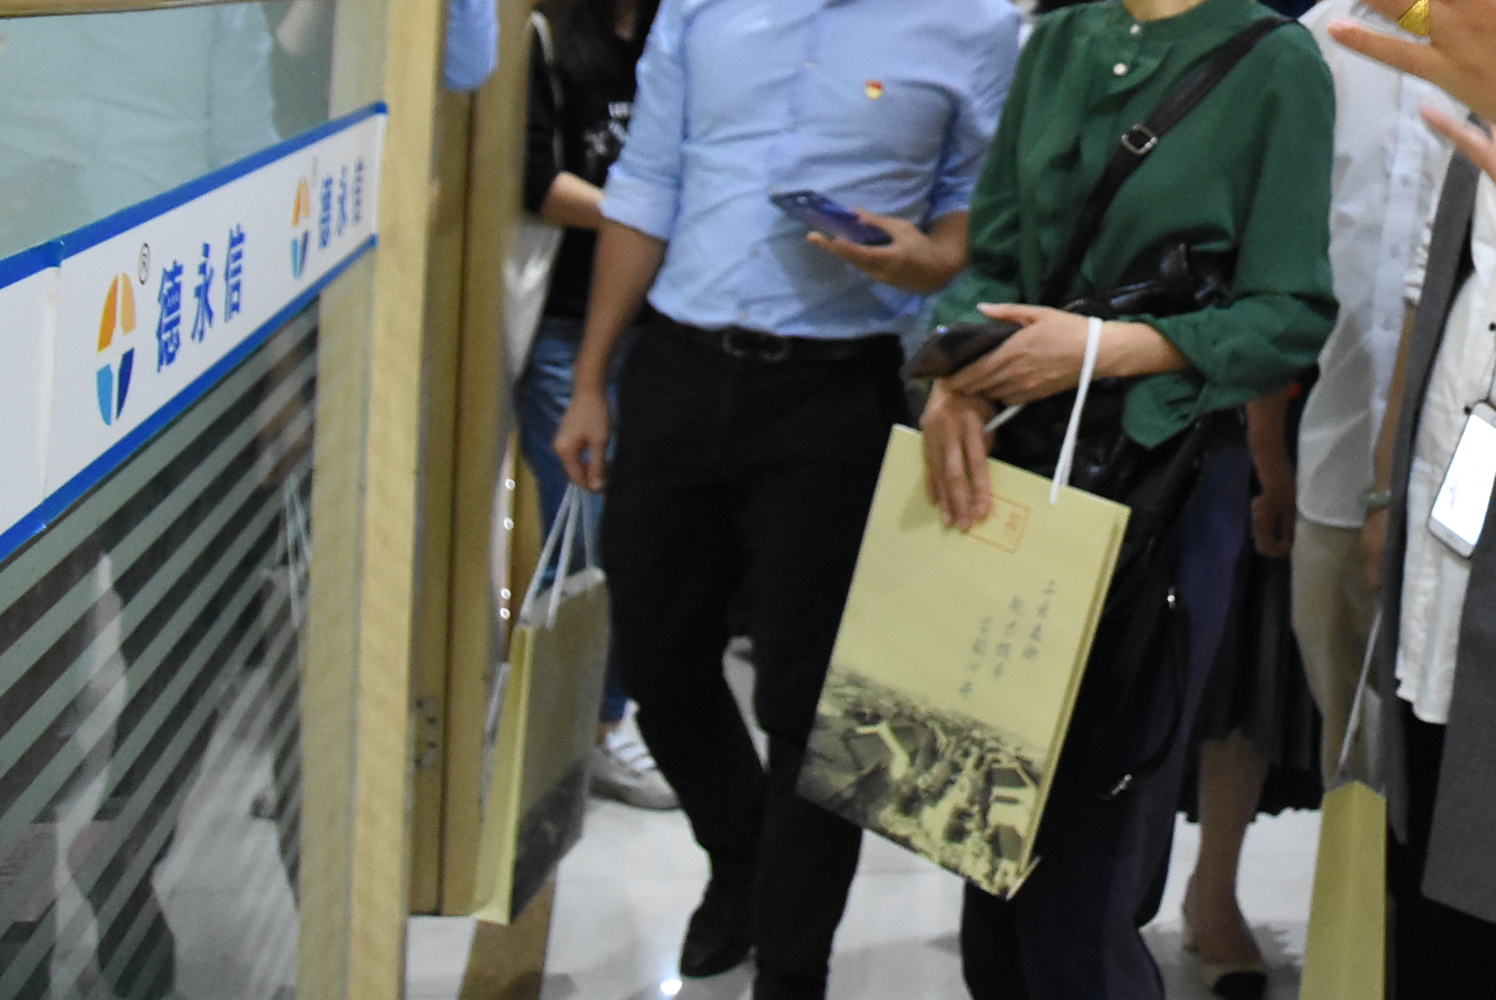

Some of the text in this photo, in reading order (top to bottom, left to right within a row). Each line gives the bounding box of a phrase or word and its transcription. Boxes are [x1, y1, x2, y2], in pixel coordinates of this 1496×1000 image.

[318, 157, 366, 250] 德永信
[157, 223, 247, 373] 德永信
